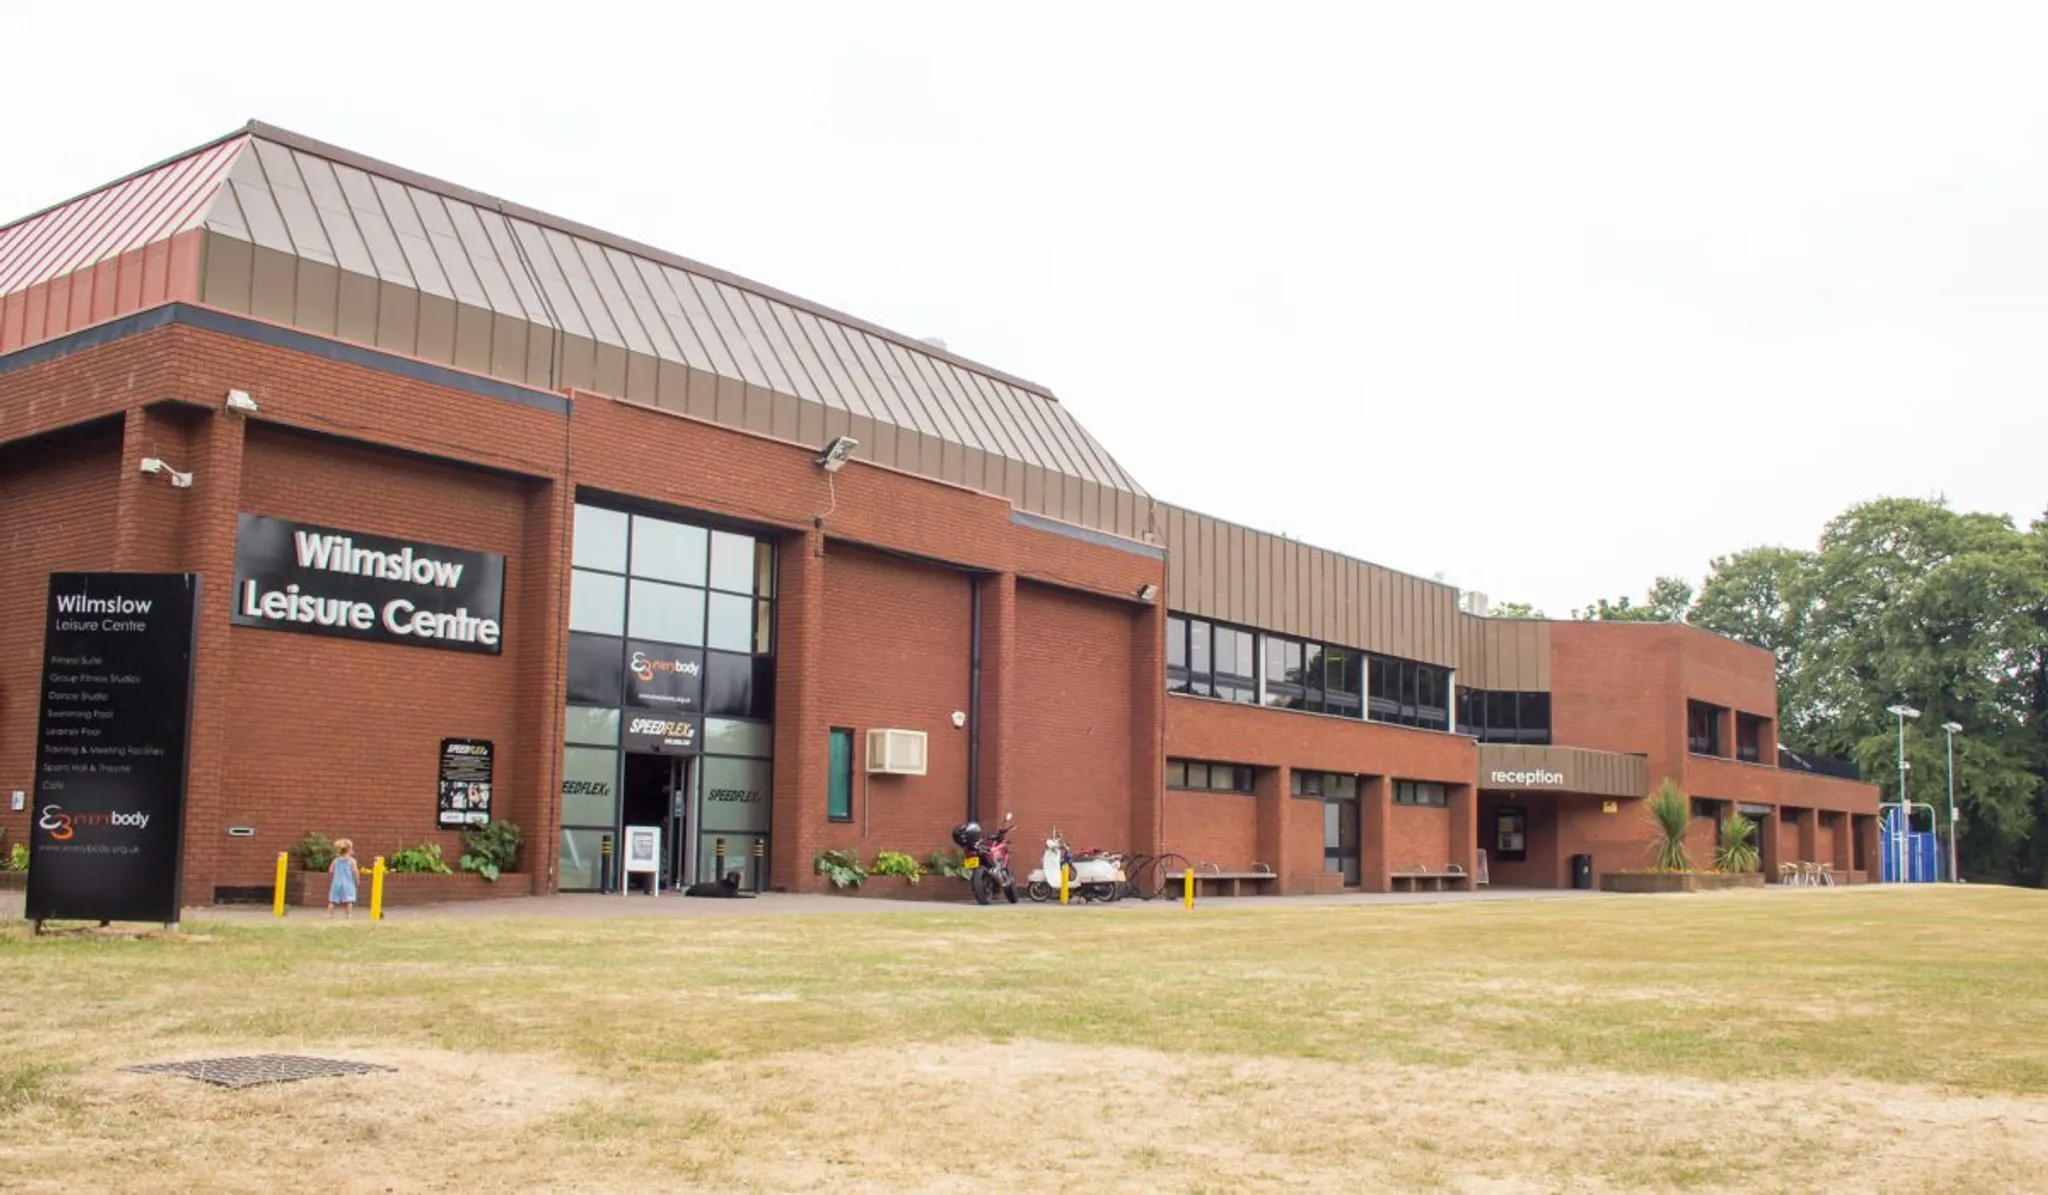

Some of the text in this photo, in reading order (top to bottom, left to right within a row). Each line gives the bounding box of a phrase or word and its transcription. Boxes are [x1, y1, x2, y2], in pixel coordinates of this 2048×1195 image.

[294, 530, 464, 588] Wilmslow
[56, 594, 152, 614] Wilmslow
[243, 579, 501, 645] Leisure Centre
[56, 619, 146, 632] Leisure Centre
[48, 691, 79, 701] Dance
[629, 718, 691, 737] SPEEDFLEX
[81, 746, 87, 754] &
[90, 764, 97, 772] &
[1491, 769, 1563, 786] reception
